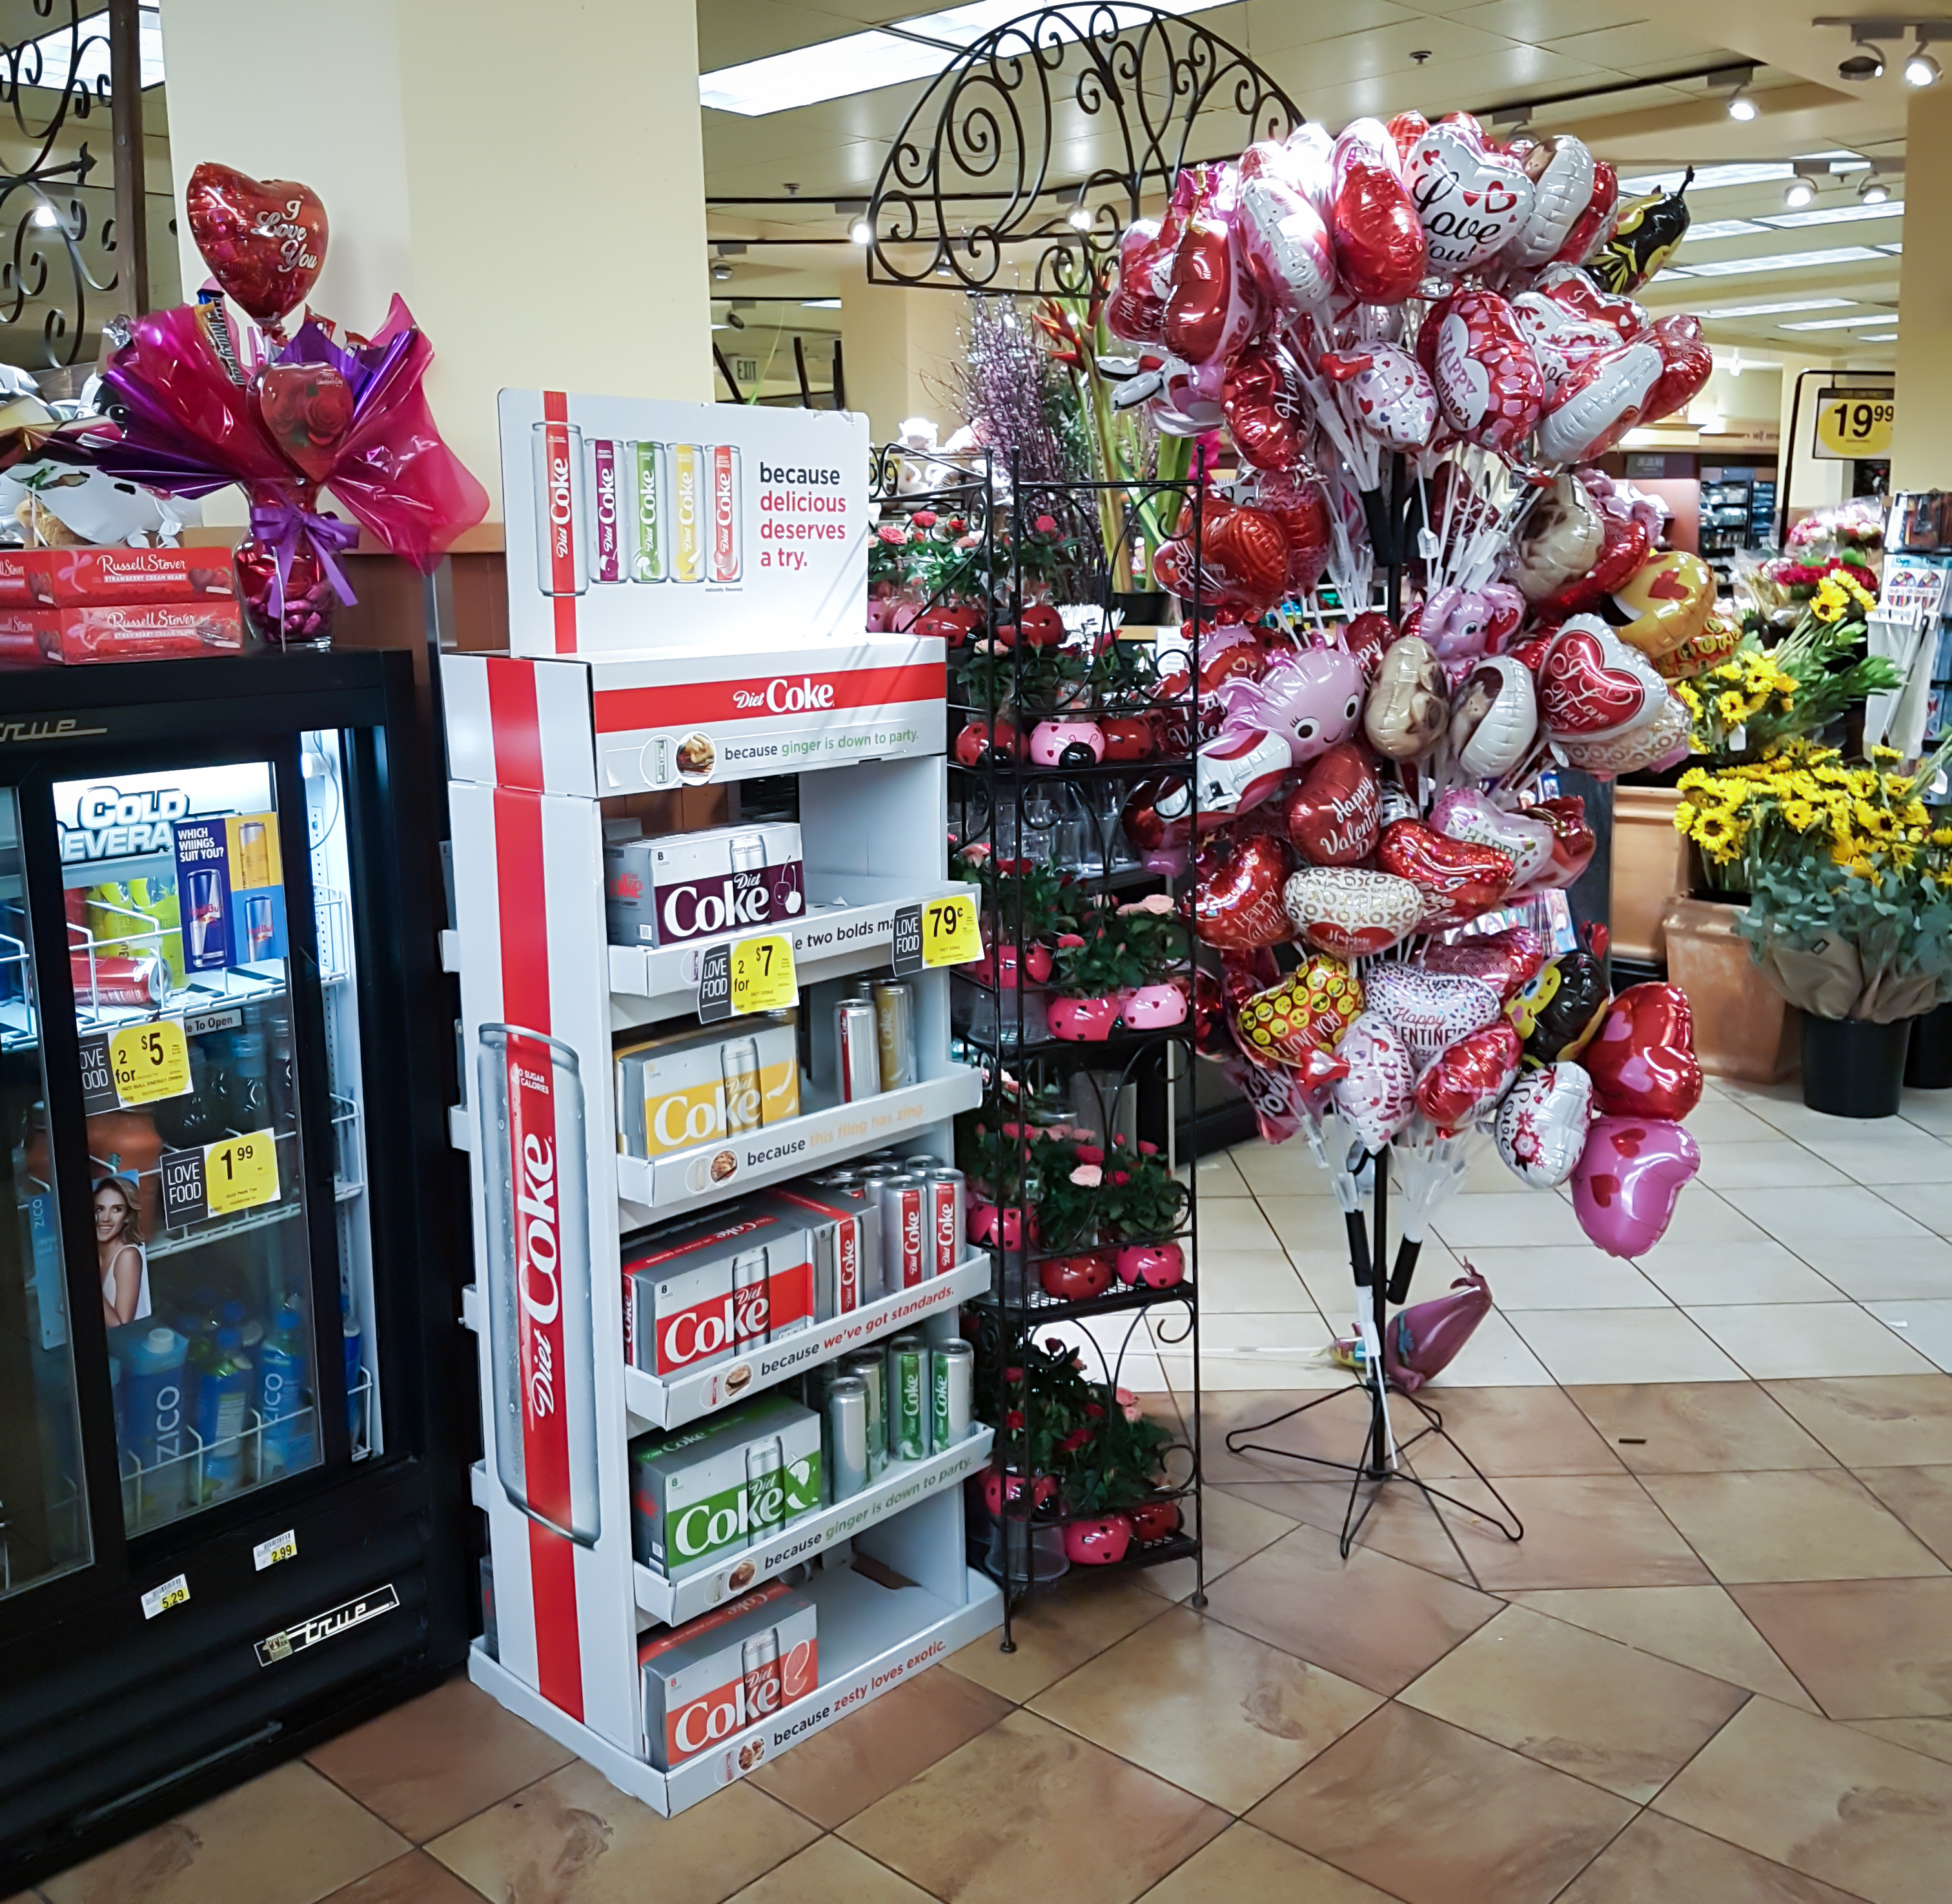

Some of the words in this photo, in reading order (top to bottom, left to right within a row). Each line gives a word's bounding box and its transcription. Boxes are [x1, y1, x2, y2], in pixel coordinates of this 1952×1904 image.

[281, 200, 301, 220] I
[1412, 171, 1501, 245] Love
[250, 211, 307, 241] Love
[278, 240, 318, 273] You
[1428, 240, 1478, 263] ou!
[737, 360, 756, 380] EXIT
[759, 462, 840, 485] because
[551, 458, 571, 525] Coke
[599, 467, 615, 524] Coke
[640, 470, 656, 525] Coke
[678, 471, 694, 526] Coke
[717, 472, 731, 526] Coke
[760, 491, 846, 513] delicious
[604, 526, 614, 552] Diet
[644, 527, 653, 552] Diet
[682, 528, 691, 553] Diet
[760, 519, 846, 540] deserves
[556, 527, 567, 558] Diet
[97, 555, 144, 575] Russell
[148, 554, 186, 571] Stover
[760, 549, 771, 567] a
[777, 548, 808, 570] try.
[108, 610, 154, 631] Russell
[159, 609, 194, 627] Stover
[733, 690, 764, 710] Diet
[766, 679, 835, 712] Coke
[725, 744, 778, 760] because
[782, 741, 821, 757] ginger
[825, 737, 834, 750] is
[838, 735, 871, 748] down
[875, 733, 886, 744] to
[890, 730, 919, 744] party.
[79, 786, 188, 830] COLD
[1332, 777, 1375, 823] Happy
[178, 827, 208, 841] WHICH
[1320, 799, 1383, 855] Valentin
[57, 817, 175, 863] EVERA
[180, 850, 199, 862] SUIT
[200, 847, 224, 859] YOU?
[657, 852, 664, 861] 8
[611, 873, 643, 898] oke
[734, 873, 761, 889] Diet
[664, 881, 770, 936] Coke
[1234, 885, 1279, 928] Happy
[896, 917, 919, 936] LOVE
[930, 905, 963, 937] 79¢
[808, 933, 833, 947] two
[837, 921, 873, 941] bolds
[897, 936, 920, 954] FOOD
[704, 957, 727, 979] LOVE
[738, 960, 744, 974] 2
[756, 945, 773, 976] $7
[702, 978, 728, 999] FOOD
[734, 978, 750, 993] for
[196, 1021, 205, 1030] To
[208, 1017, 233, 1030] Open
[879, 1008, 894, 1050] Coke
[1312, 1008, 1342, 1038] YOU
[1393, 1007, 1447, 1028] Happy
[141, 1032, 164, 1066] $5
[1275, 1043, 1290, 1058] I
[1283, 1028, 1315, 1056] LOVE
[79, 1048, 106, 1070] OVE
[118, 1050, 128, 1065] 2
[82, 1069, 109, 1090] OOD
[115, 1069, 136, 1084] for
[521, 1078, 549, 1094] CALORIES
[525, 1070, 545, 1083] SUGAR
[726, 1075, 754, 1093] Diet
[655, 1085, 762, 1146] Coke
[747, 1140, 806, 1166] because
[810, 1130, 833, 1147] this
[838, 1120, 868, 1136] fling
[871, 1113, 893, 1128] has
[897, 1105, 925, 1121] zing.
[167, 1162, 200, 1185] LOVE
[169, 1182, 201, 1205] FOOD
[32, 1198, 43, 1228] ZICO
[937, 1203, 954, 1247] Coke
[518, 1134, 559, 1324] Coke
[716, 1222, 757, 1239] Coke
[904, 1211, 920, 1254] Coke
[842, 1238, 855, 1286] Coke
[910, 1256, 918, 1276] Diet
[942, 1247, 950, 1267] Diet
[662, 1285, 667, 1294] 8
[735, 1285, 762, 1305] Diet
[665, 1298, 769, 1364] Coke
[761, 1343, 820, 1376] because
[824, 1326, 862, 1350] we've
[866, 1313, 888, 1333] got
[891, 1286, 954, 1321] standards.
[531, 1328, 554, 1418] Diet
[263, 1373, 283, 1425] ZICO
[904, 1374, 919, 1416] Coke
[935, 1375, 947, 1417] Coke
[157, 1386, 180, 1463] ZICO
[662, 1432, 708, 1452] Coke
[749, 1474, 777, 1495] Diet
[676, 1486, 784, 1556] Coke
[765, 1532, 822, 1570] because
[825, 1509, 868, 1540] ginger
[872, 1502, 882, 1515] is
[886, 1483, 920, 1508] down
[924, 1475, 936, 1489] to
[939, 1457, 972, 1484] party.
[271, 1544, 293, 1562] 2.99
[161, 1590, 185, 1609] 5.29
[726, 1593, 768, 1615] Coke
[294, 1602, 381, 1644] true
[746, 1666, 773, 1688] Diet
[774, 1706, 829, 1746] because
[834, 1684, 868, 1712] zesty
[871, 1664, 904, 1691] loves
[906, 1639, 946, 1669] exotic.
[675, 1678, 780, 1752] Coke
